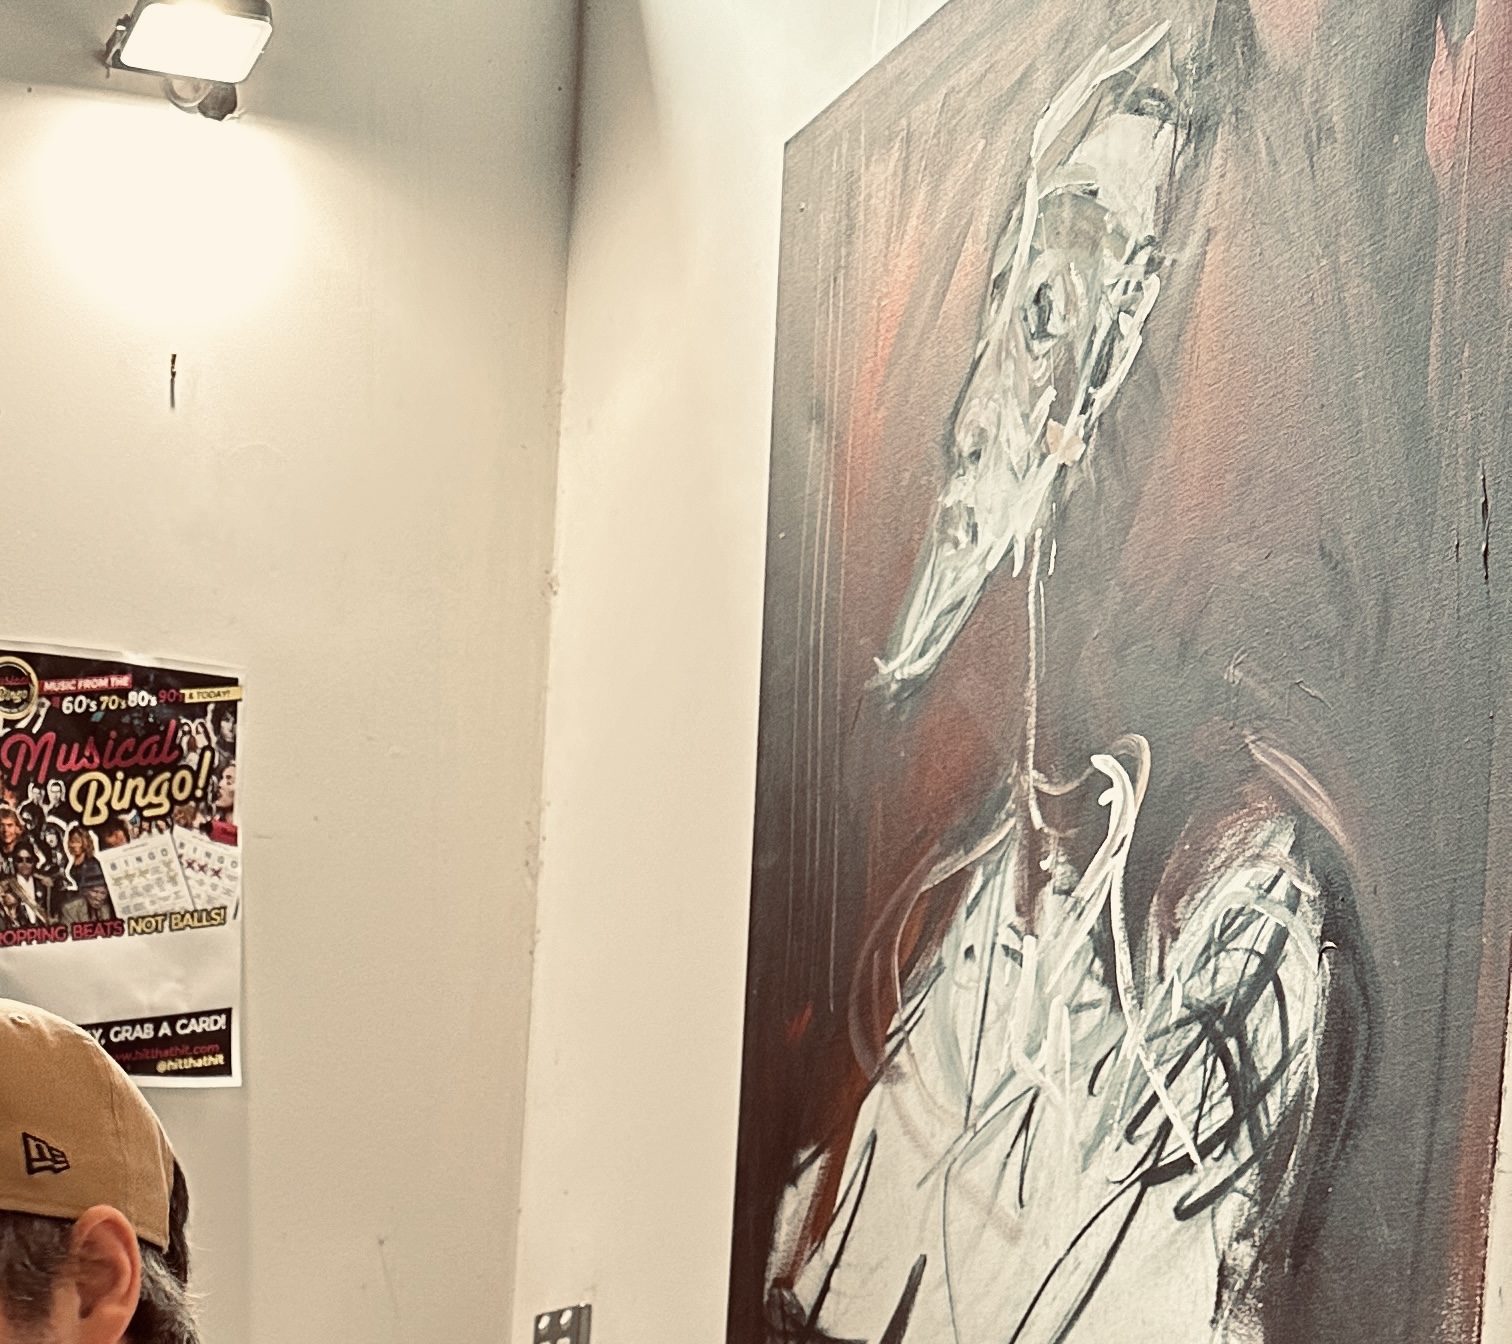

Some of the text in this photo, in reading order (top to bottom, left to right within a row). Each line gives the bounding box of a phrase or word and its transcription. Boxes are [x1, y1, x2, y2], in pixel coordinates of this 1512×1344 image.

[43, 676, 130, 692] MUSIC FROM THE
[61, 694, 98, 715] 60's
[99, 695, 127, 711] 70's
[127, 690, 158, 708] 80's
[158, 689, 184, 703] 90's
[0, 719, 181, 786] Musical
[69, 750, 212, 826] Bingo!
[72, 920, 124, 940] BEATS
[128, 916, 166, 936] NOT
[170, 908, 226, 931] BALLS!
[109, 1023, 155, 1043] GRAB
[157, 1021, 172, 1038] A
[175, 1014, 227, 1035] CARD!
